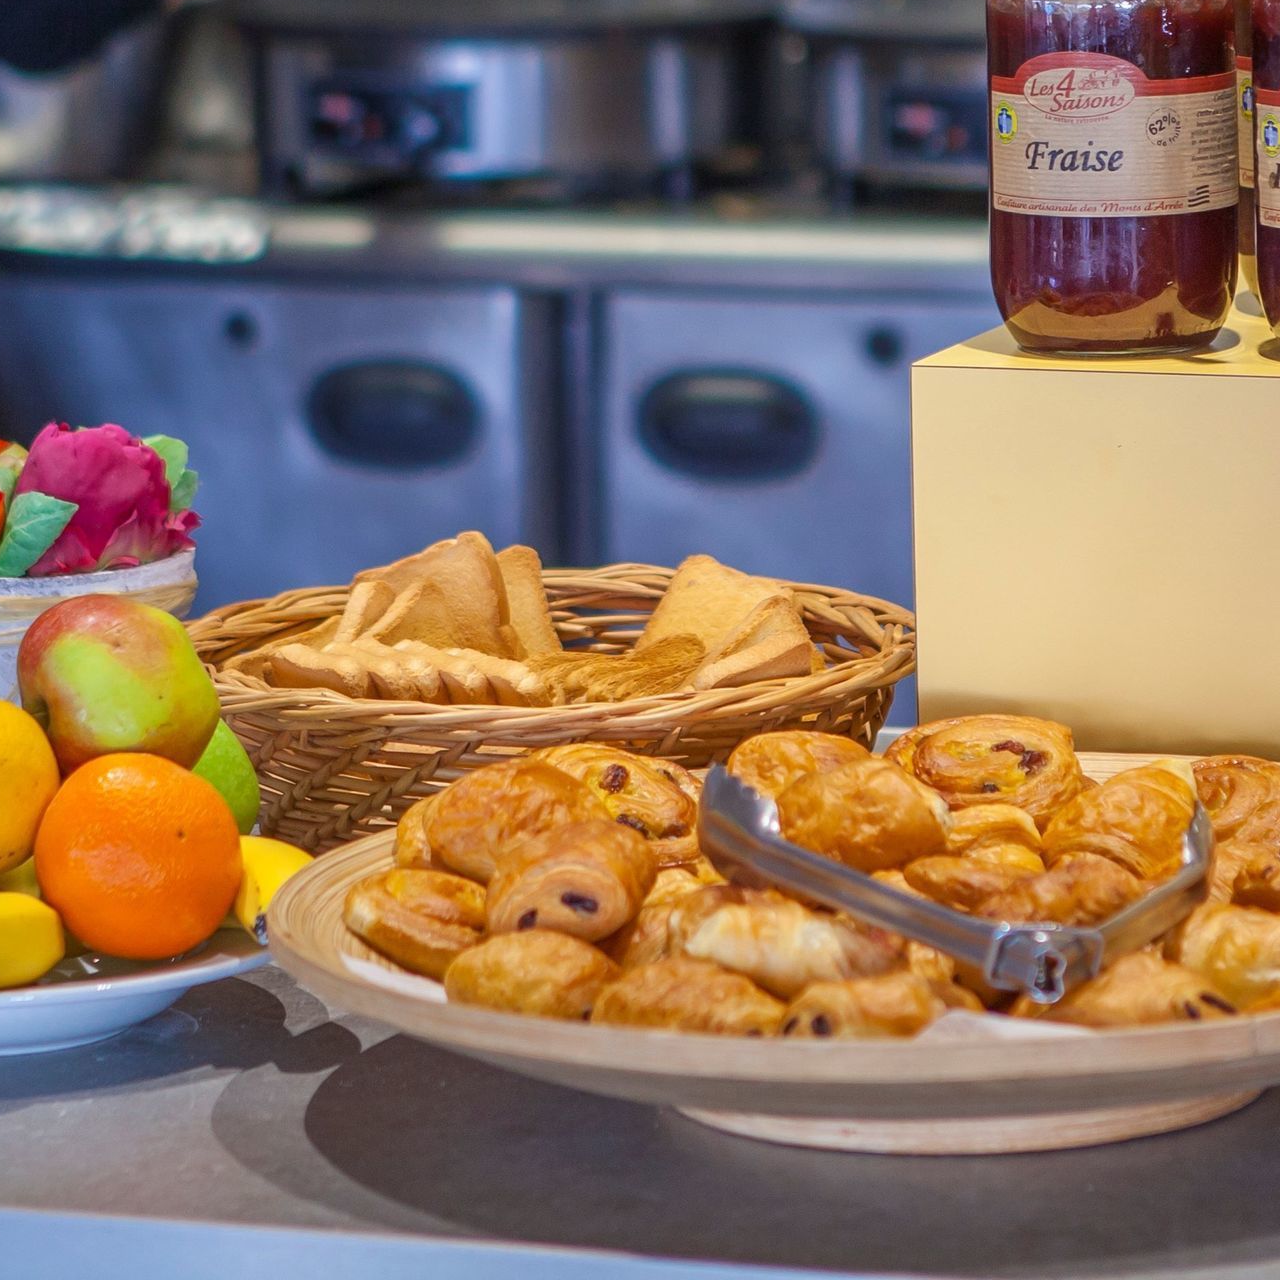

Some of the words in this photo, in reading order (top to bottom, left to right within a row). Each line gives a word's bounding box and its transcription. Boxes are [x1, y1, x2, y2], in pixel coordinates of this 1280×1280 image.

[1030, 78, 1054, 96] Les
[1056, 70, 1075, 98] 4
[1050, 93, 1125, 112] Saisons
[1148, 113, 1177, 135] 62%
[1025, 140, 1125, 172] Fraise
[1028, 202, 1077, 212] artisanale
[1080, 203, 1097, 212] des
[1101, 202, 1141, 212] Monts
